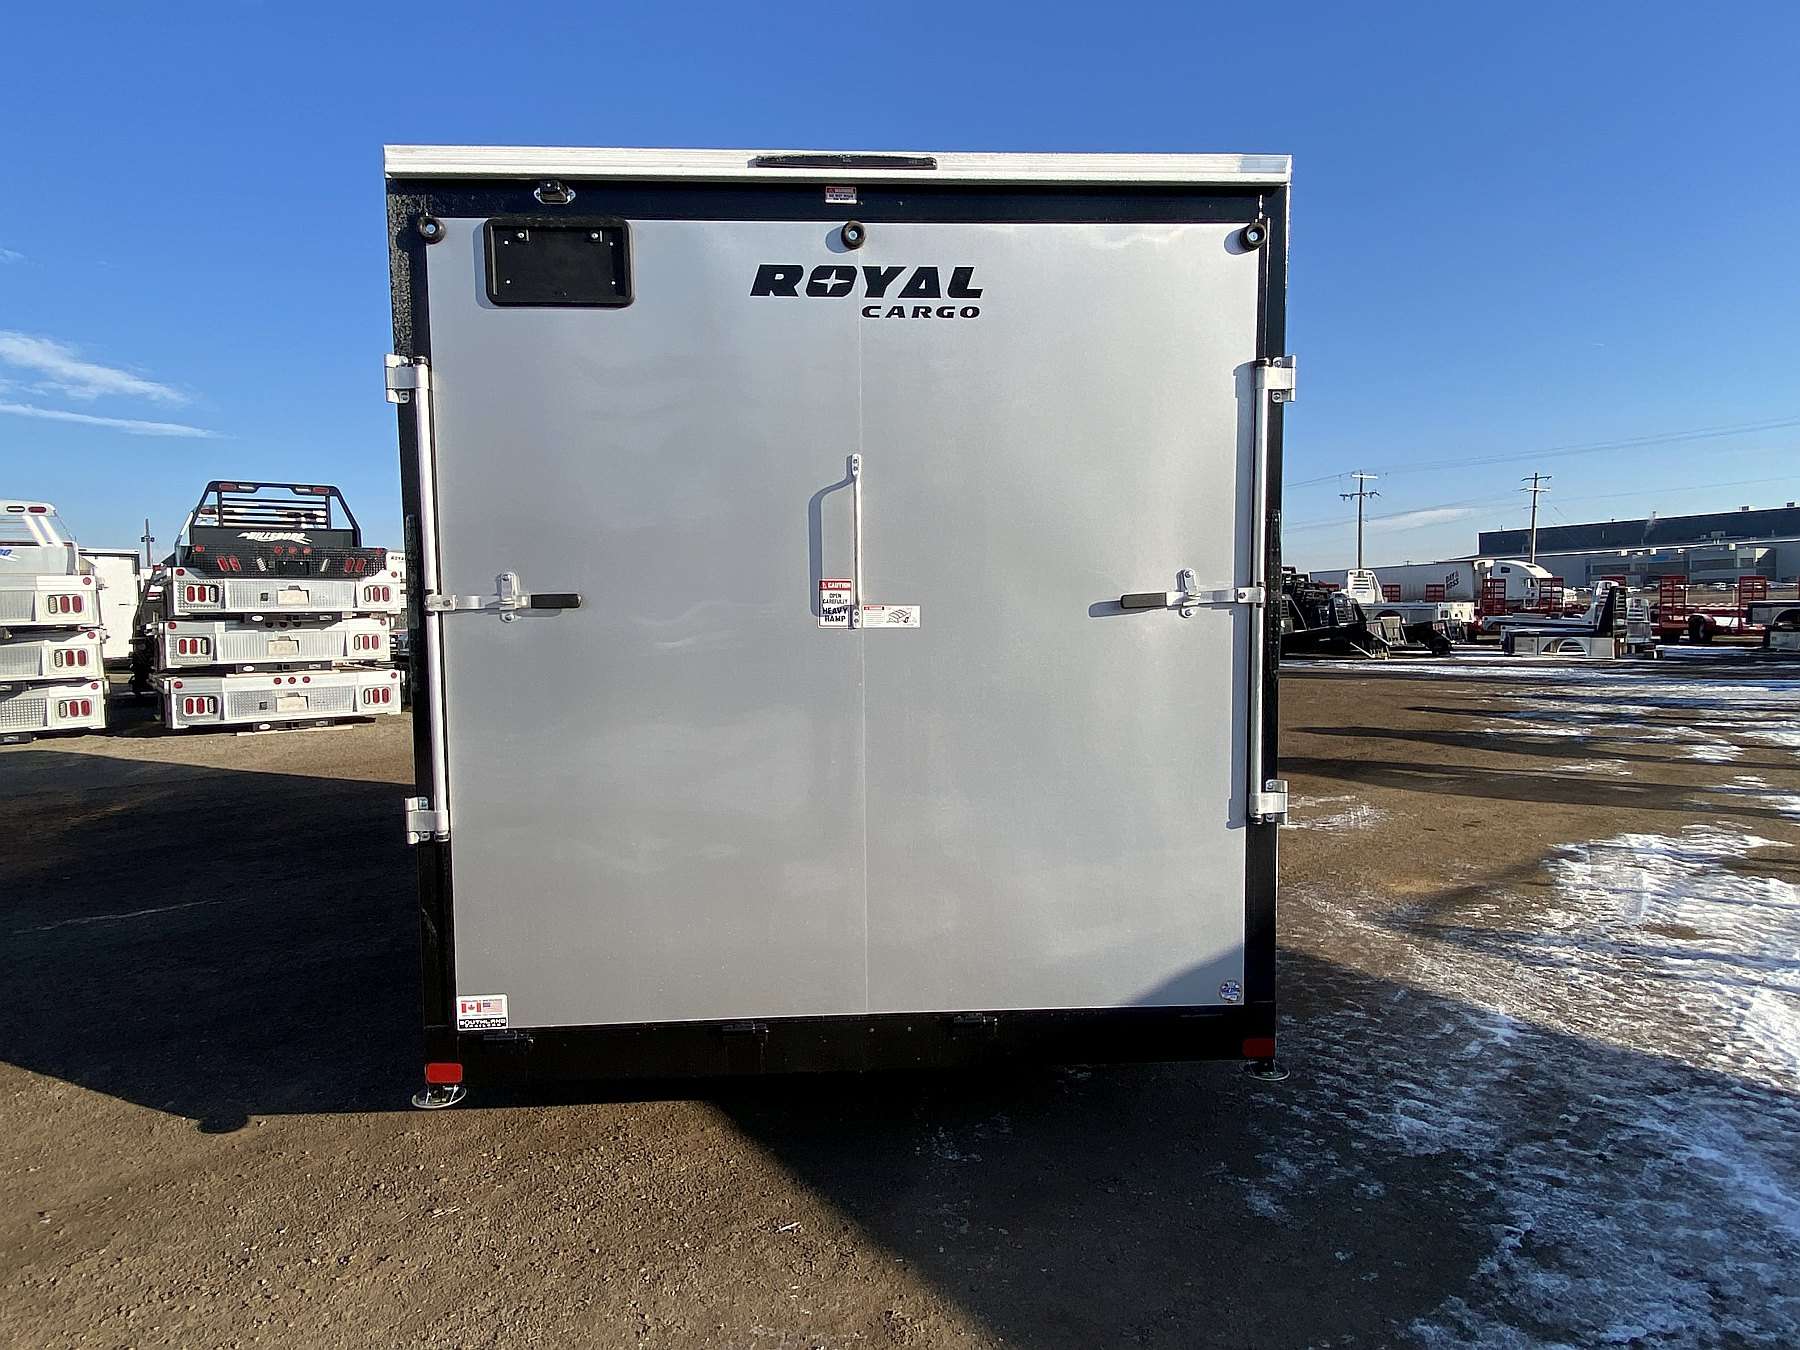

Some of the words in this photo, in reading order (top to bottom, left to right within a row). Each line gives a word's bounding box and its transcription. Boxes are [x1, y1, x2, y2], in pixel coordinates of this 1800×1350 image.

[750, 264, 983, 298] ROYAL
[861, 305, 980, 319] CARGO
[822, 607, 848, 615] HEAVY
